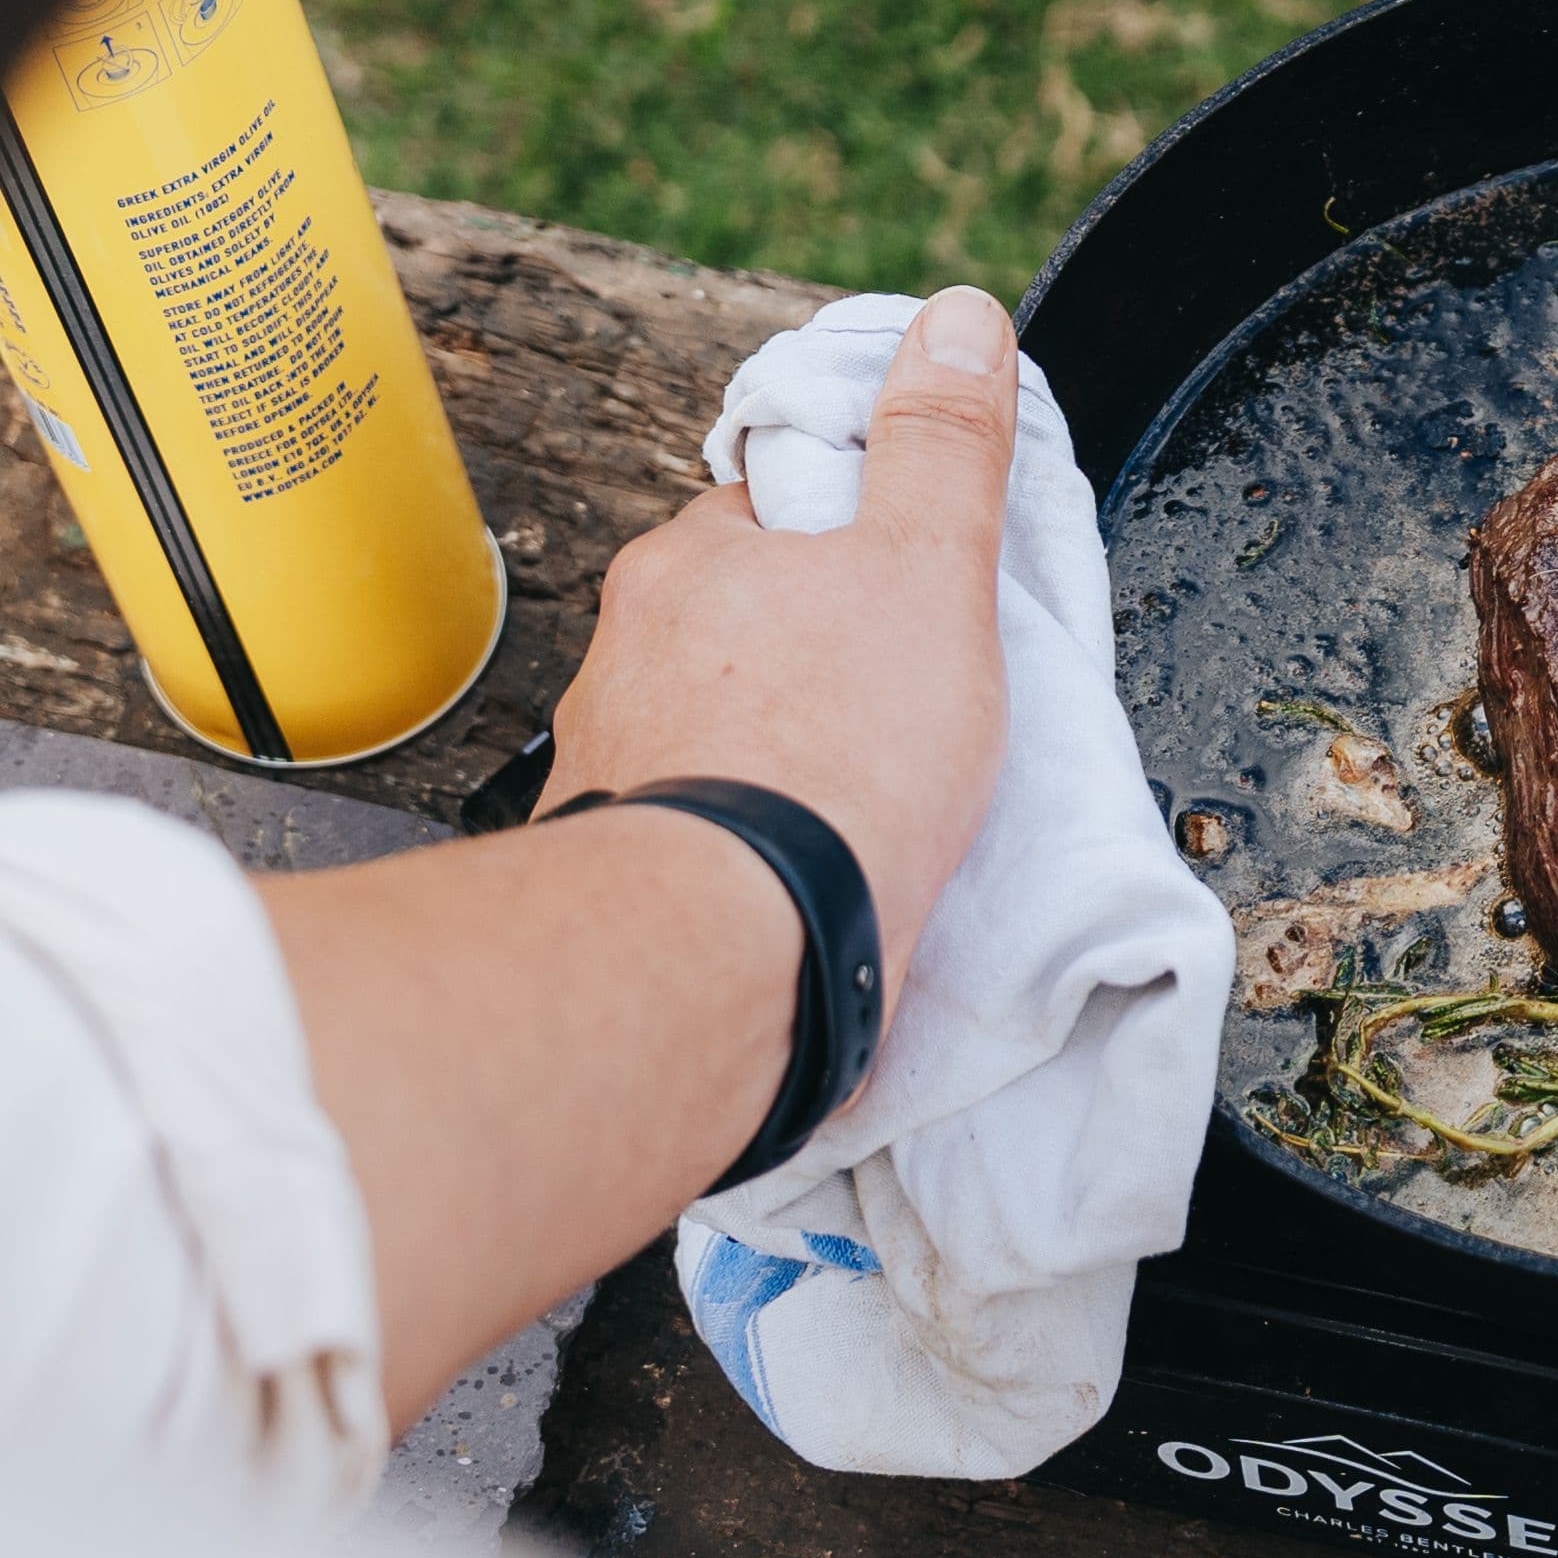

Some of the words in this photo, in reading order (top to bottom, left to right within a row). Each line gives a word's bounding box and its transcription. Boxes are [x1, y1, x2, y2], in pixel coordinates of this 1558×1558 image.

[117, 189, 159, 208] GREEK
[161, 172, 199, 195] EXTRA
[201, 143, 237, 174] VIRGIN
[239, 116, 263, 146] OLIVE
[263, 99, 275, 117] OIL
[211, 165, 244, 193] EXTRA
[245, 131, 273, 165] VIRGIN
[131, 223, 168, 240] OLIVE
[171, 215, 191, 229] OIL
[139, 233, 200, 260] SUPERIOR
[203, 196, 255, 237] CATEGORY
[257, 170, 281, 199] OLIVE
[144, 261, 165, 273] OIL
[169, 235, 226, 266] OBTAINED
[228, 199, 272, 239] DIRECTLY
[274, 170, 295, 200] FROM
[149, 266, 194, 286] OLIVES
[198, 254, 221, 271] AND
[224, 226, 260, 257] SOLELY
[263, 213, 275, 229] BY
[155, 265, 232, 299] MECHANICAL
[163, 300, 202, 318] STORE
[207, 284, 235, 305] AWAY
[239, 263, 269, 288] FROM
[271, 237, 295, 266] LIGHT
[297, 216, 312, 238] AND
[175, 332, 186, 343] AT
[192, 321, 223, 338] COLD
[226, 266, 302, 325] TEMPERATURES
[303, 248, 317, 267] THE
[179, 344, 200, 355] OIL
[202, 332, 233, 348] WILL
[236, 304, 279, 336] BECOME
[282, 270, 313, 306] CLOUDY
[316, 249, 329, 270] AND
[184, 351, 220, 367] START
[224, 344, 238, 355] TO
[292, 290, 312, 312] THIS
[314, 278, 322, 291] IS
[189, 359, 239, 380] NORMAL
[244, 345, 266, 362] AND
[268, 327, 293, 347] WILL
[295, 275, 338, 328] DISAPPEAR
[204, 307, 221, 320] DO
[224, 294, 245, 312] NOT
[289, 349, 303, 365] DO
[305, 331, 321, 352] NOT
[323, 305, 343, 333] POUR
[194, 376, 230, 392] WHEN
[233, 345, 289, 380] RETURNED
[291, 333, 304, 346] TO
[305, 306, 329, 335] ROOM
[210, 409, 252, 428] REJECT
[256, 403, 266, 413] IF
[271, 387, 297, 406] SEAL
[300, 375, 310, 388] IS
[312, 340, 345, 378] BROKEN
[231, 397, 251, 409] OIL
[254, 379, 284, 400] BACK
[286, 361, 309, 382] INTO
[310, 344, 327, 362] THE
[215, 419, 260, 440] BEFORE
[223, 429, 284, 456] PRODUCED
[298, 393, 335, 426] PACKED
[336, 381, 346, 394] IN
[242, 449, 343, 503] WWW.ODYSEA.COM
[1277, 1506, 1389, 1539] CHARLES
